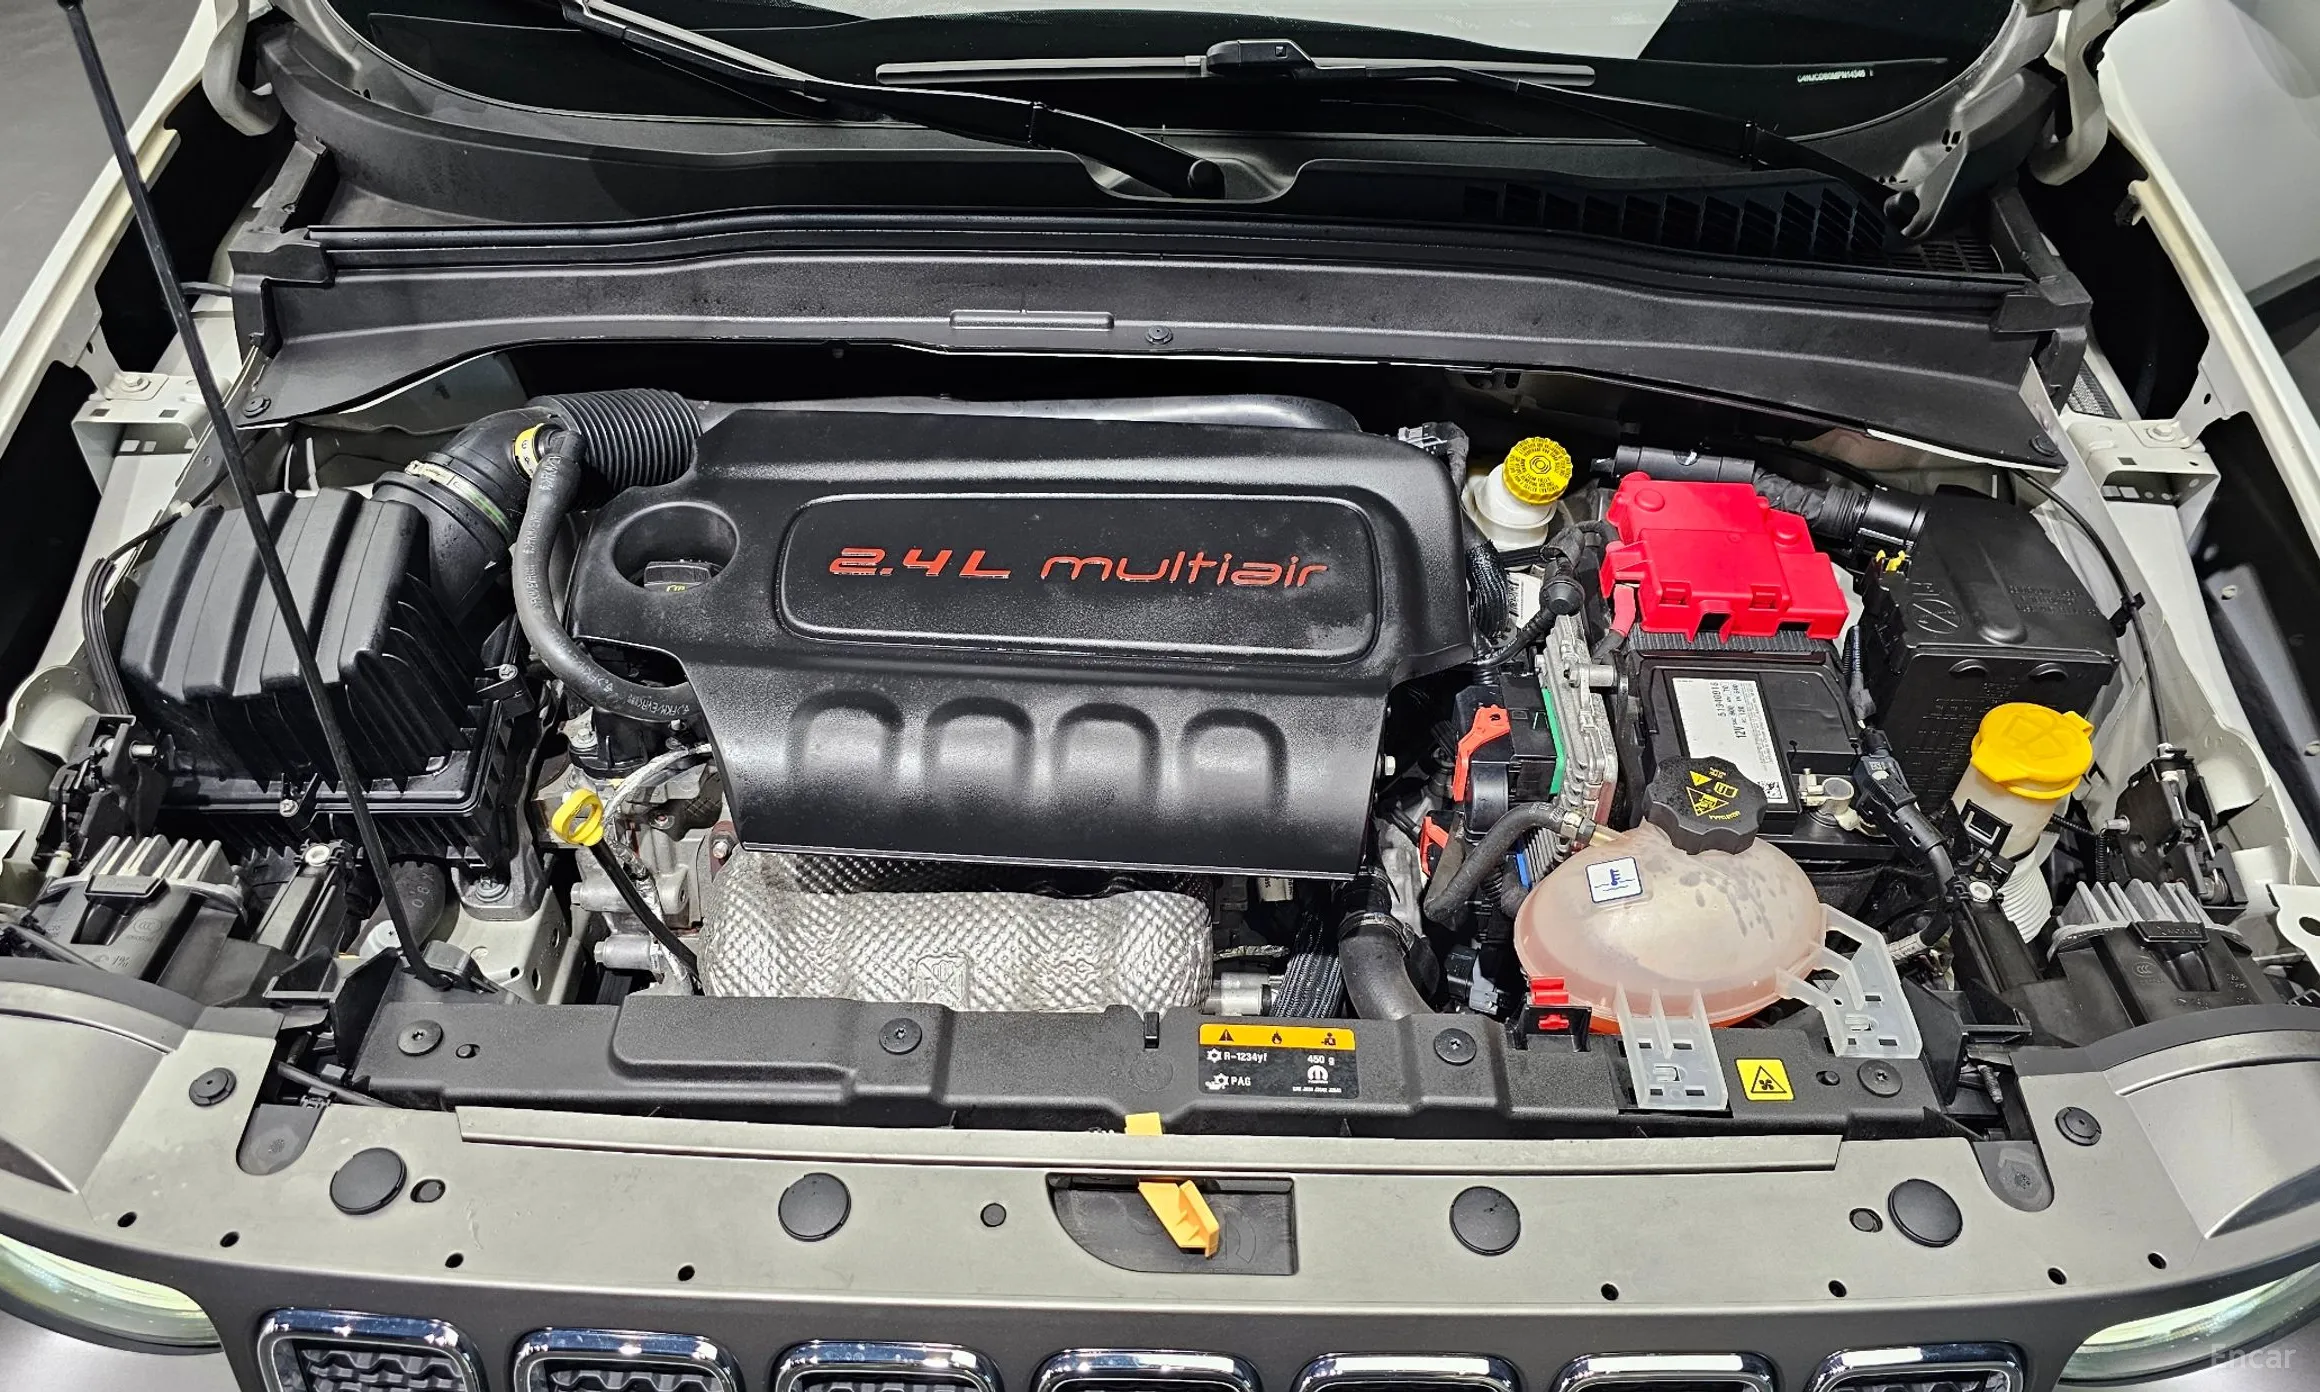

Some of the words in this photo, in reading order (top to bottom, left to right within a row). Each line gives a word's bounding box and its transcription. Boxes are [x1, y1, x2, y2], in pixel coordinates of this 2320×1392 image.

[1041, 549, 1329, 589] multiair
[1733, 726, 1747, 739] 12V
[1224, 1052, 1268, 1063] R-1234yf
[1307, 1055, 1325, 1064] 450
[1328, 1057, 1335, 1066] g
[1230, 1077, 1251, 1087] PAG
